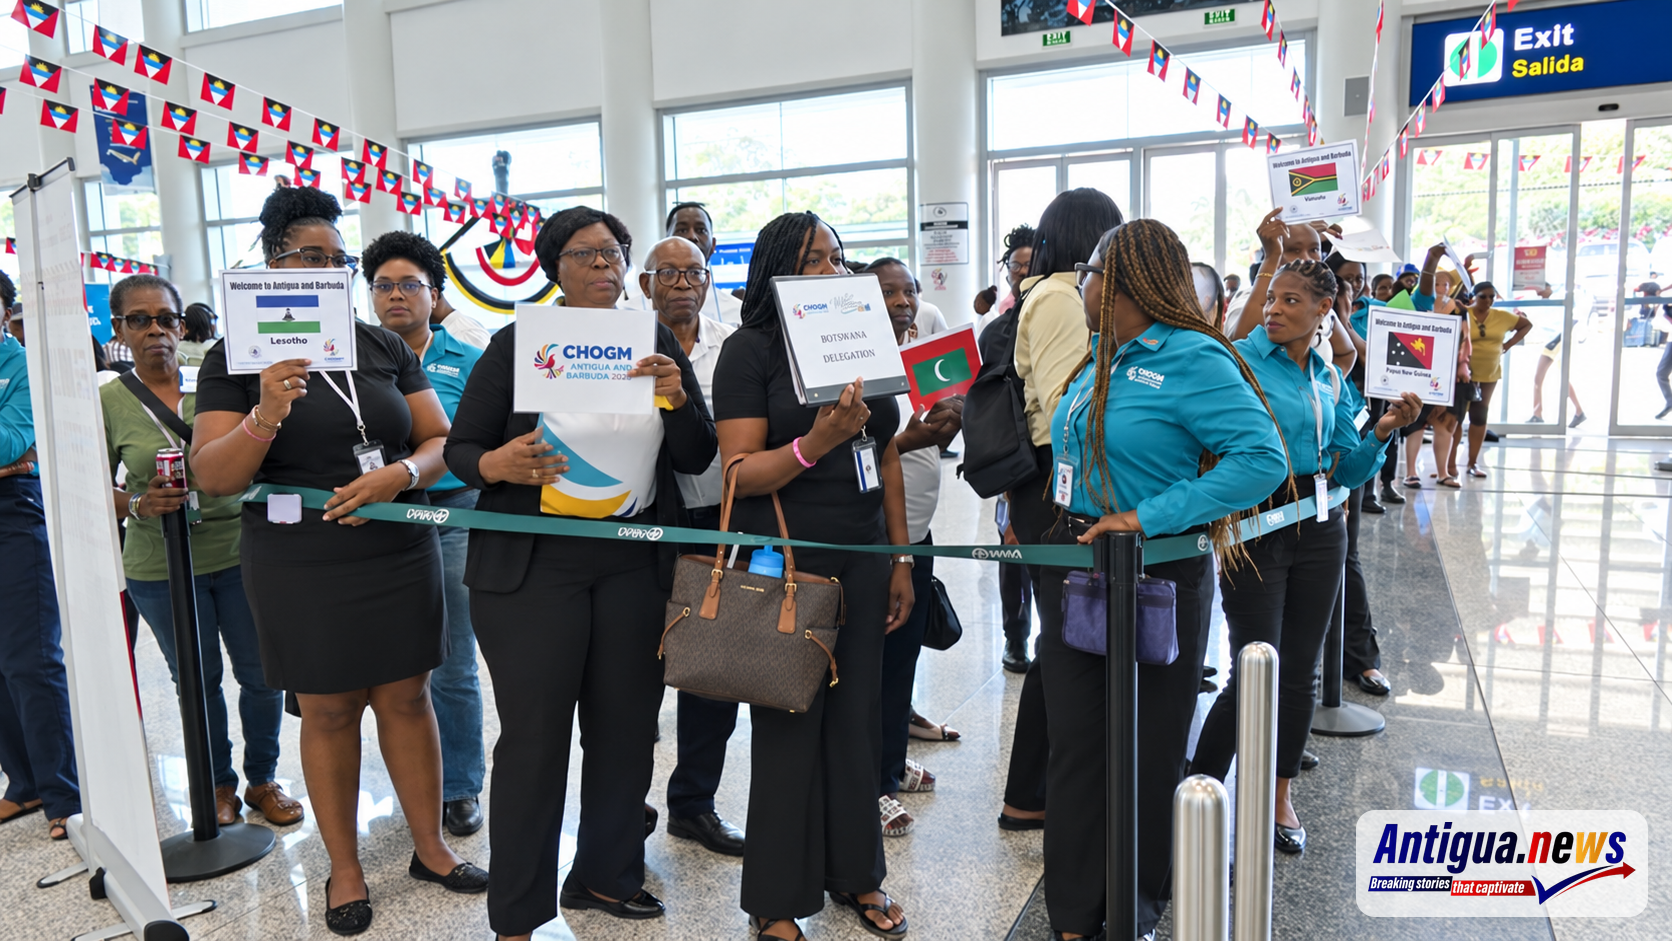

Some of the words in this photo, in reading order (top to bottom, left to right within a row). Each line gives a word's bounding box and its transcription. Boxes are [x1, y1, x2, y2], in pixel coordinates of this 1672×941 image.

[1513, 23, 1575, 51] Exit
[1512, 54, 1585, 78] Salida
[230, 281, 263, 291] Welcome
[264, 281, 272, 290] to
[273, 281, 300, 291] Antigua
[301, 281, 314, 290] and
[315, 281, 345, 290] Barbuda
[803, 303, 828, 311] CHOGM
[270, 337, 308, 345] Lesotho
[821, 330, 868, 343] BOTSWANA
[562, 345, 632, 361] CHOGM
[823, 348, 876, 363] DELEGATION
[570, 363, 611, 371] ANTIGUA
[613, 364, 633, 372] AND
[566, 372, 609, 380] BARBUDA
